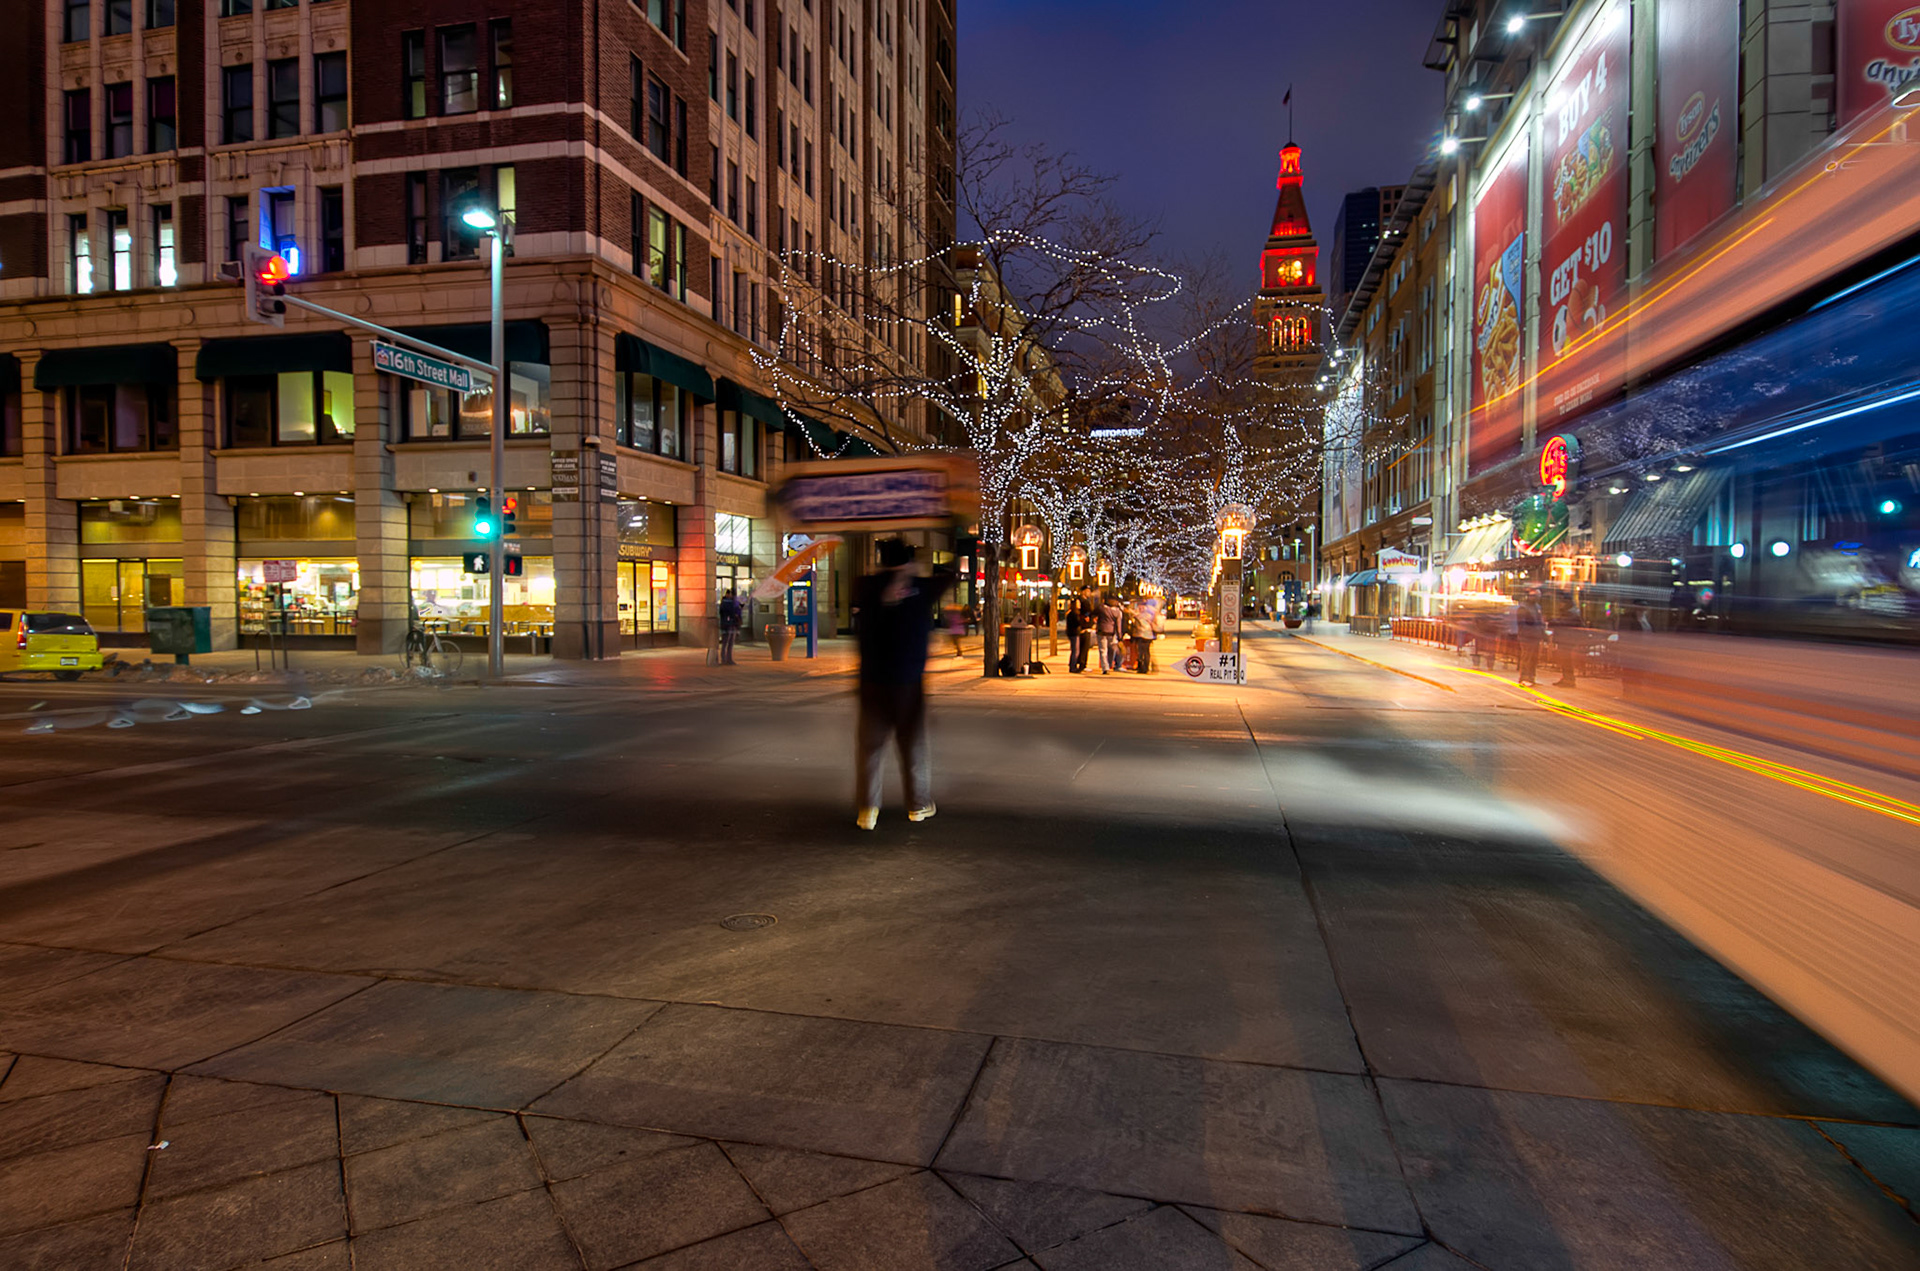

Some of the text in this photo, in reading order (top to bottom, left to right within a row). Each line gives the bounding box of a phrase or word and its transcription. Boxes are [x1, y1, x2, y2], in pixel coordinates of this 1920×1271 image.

[1558, 51, 1608, 147] BUY 4
[1679, 100, 1703, 136] Tyson
[1550, 246, 1582, 307] GET
[1584, 221, 1612, 273] $10
[389, 350, 468, 388] 16th Street Mall
[618, 544, 653, 558] SUBWAY
[1210, 669, 1245, 680] REAL PIT BQ
[1219, 654, 1236, 667] #1
